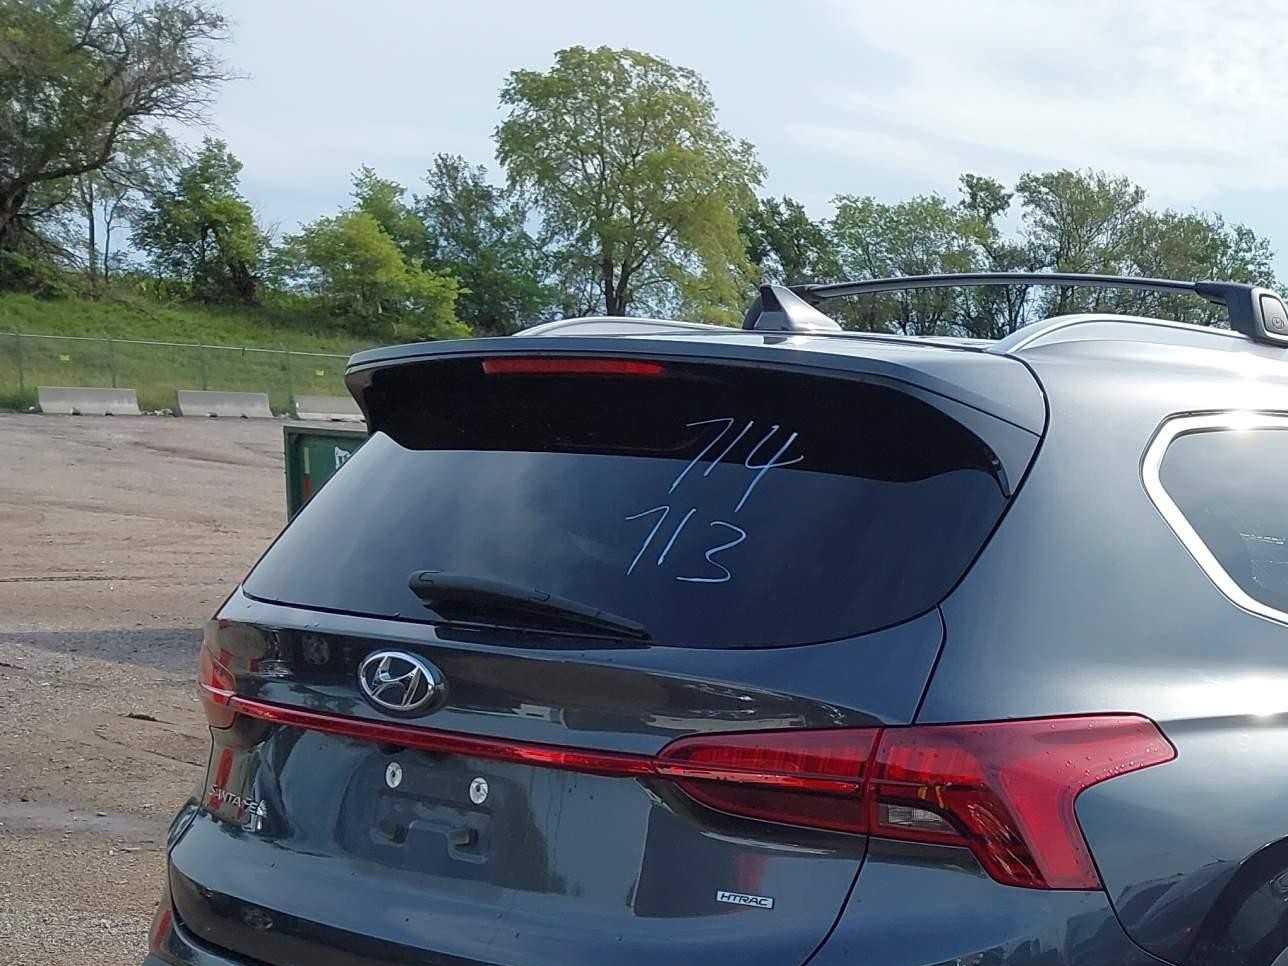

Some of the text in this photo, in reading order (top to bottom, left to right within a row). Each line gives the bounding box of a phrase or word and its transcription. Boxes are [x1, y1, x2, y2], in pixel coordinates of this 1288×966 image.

[668, 417, 804, 512] 714
[625, 505, 747, 583] 713
[719, 892, 770, 907] HTRAC
